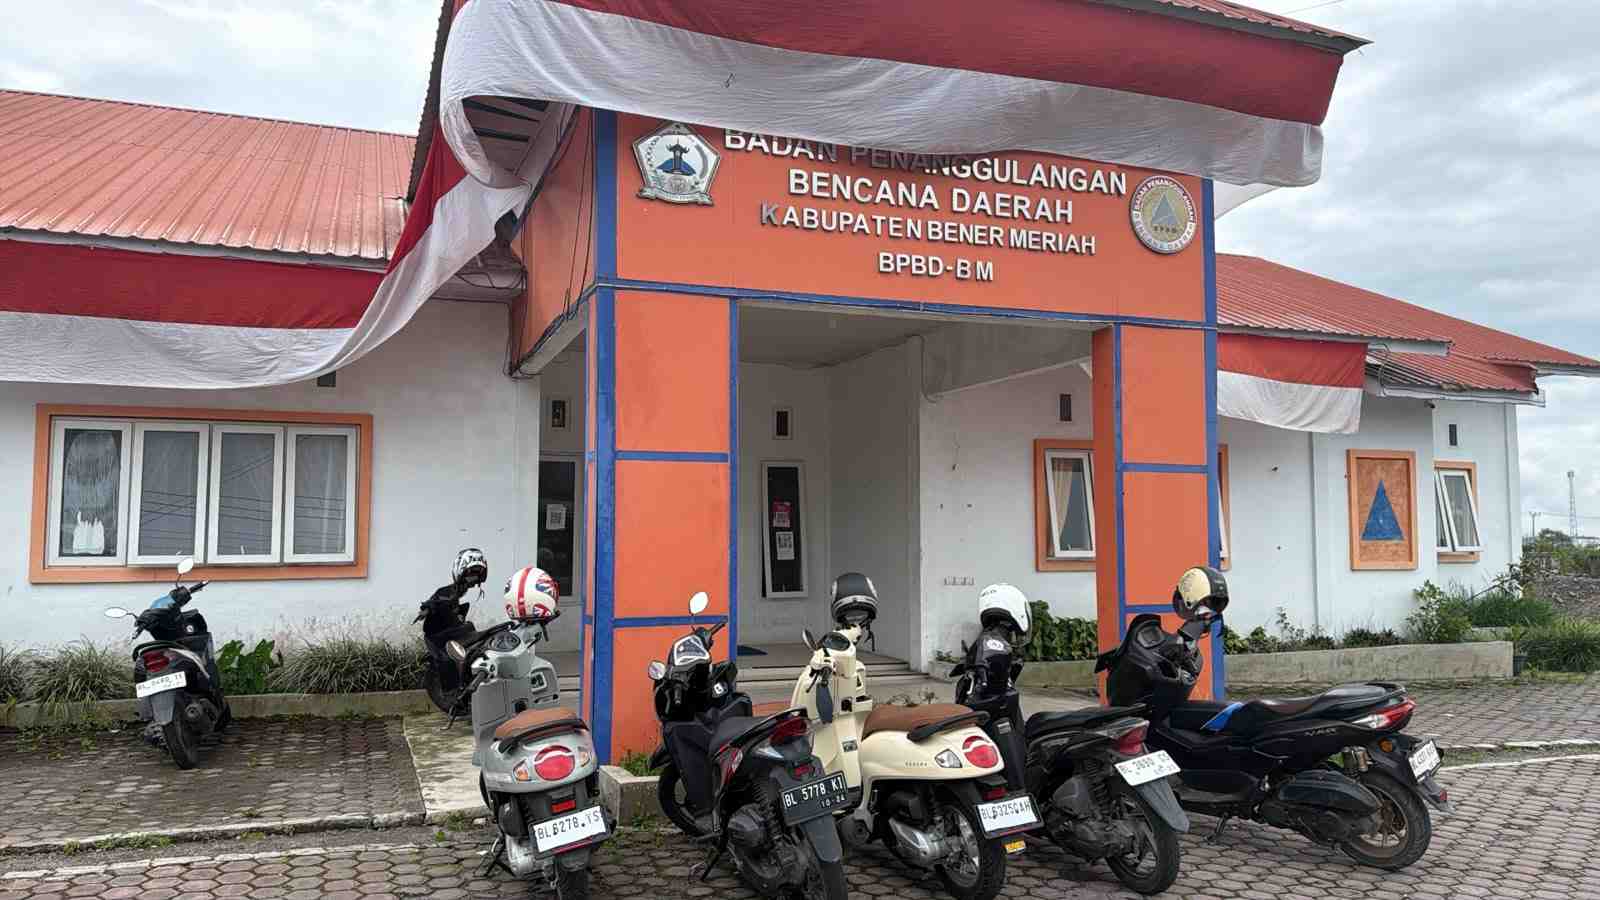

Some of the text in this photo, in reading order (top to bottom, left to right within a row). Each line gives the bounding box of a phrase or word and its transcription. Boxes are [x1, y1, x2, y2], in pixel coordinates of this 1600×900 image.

[724, 130, 1126, 195] BADAN PENANGGULANGAN
[788, 168, 1073, 224] BENCANA DAERAH
[760, 200, 1096, 254] KABUPATEN BENER MERIAH
[784, 793, 798, 807] BL
[801, 783, 826, 800] 5778
